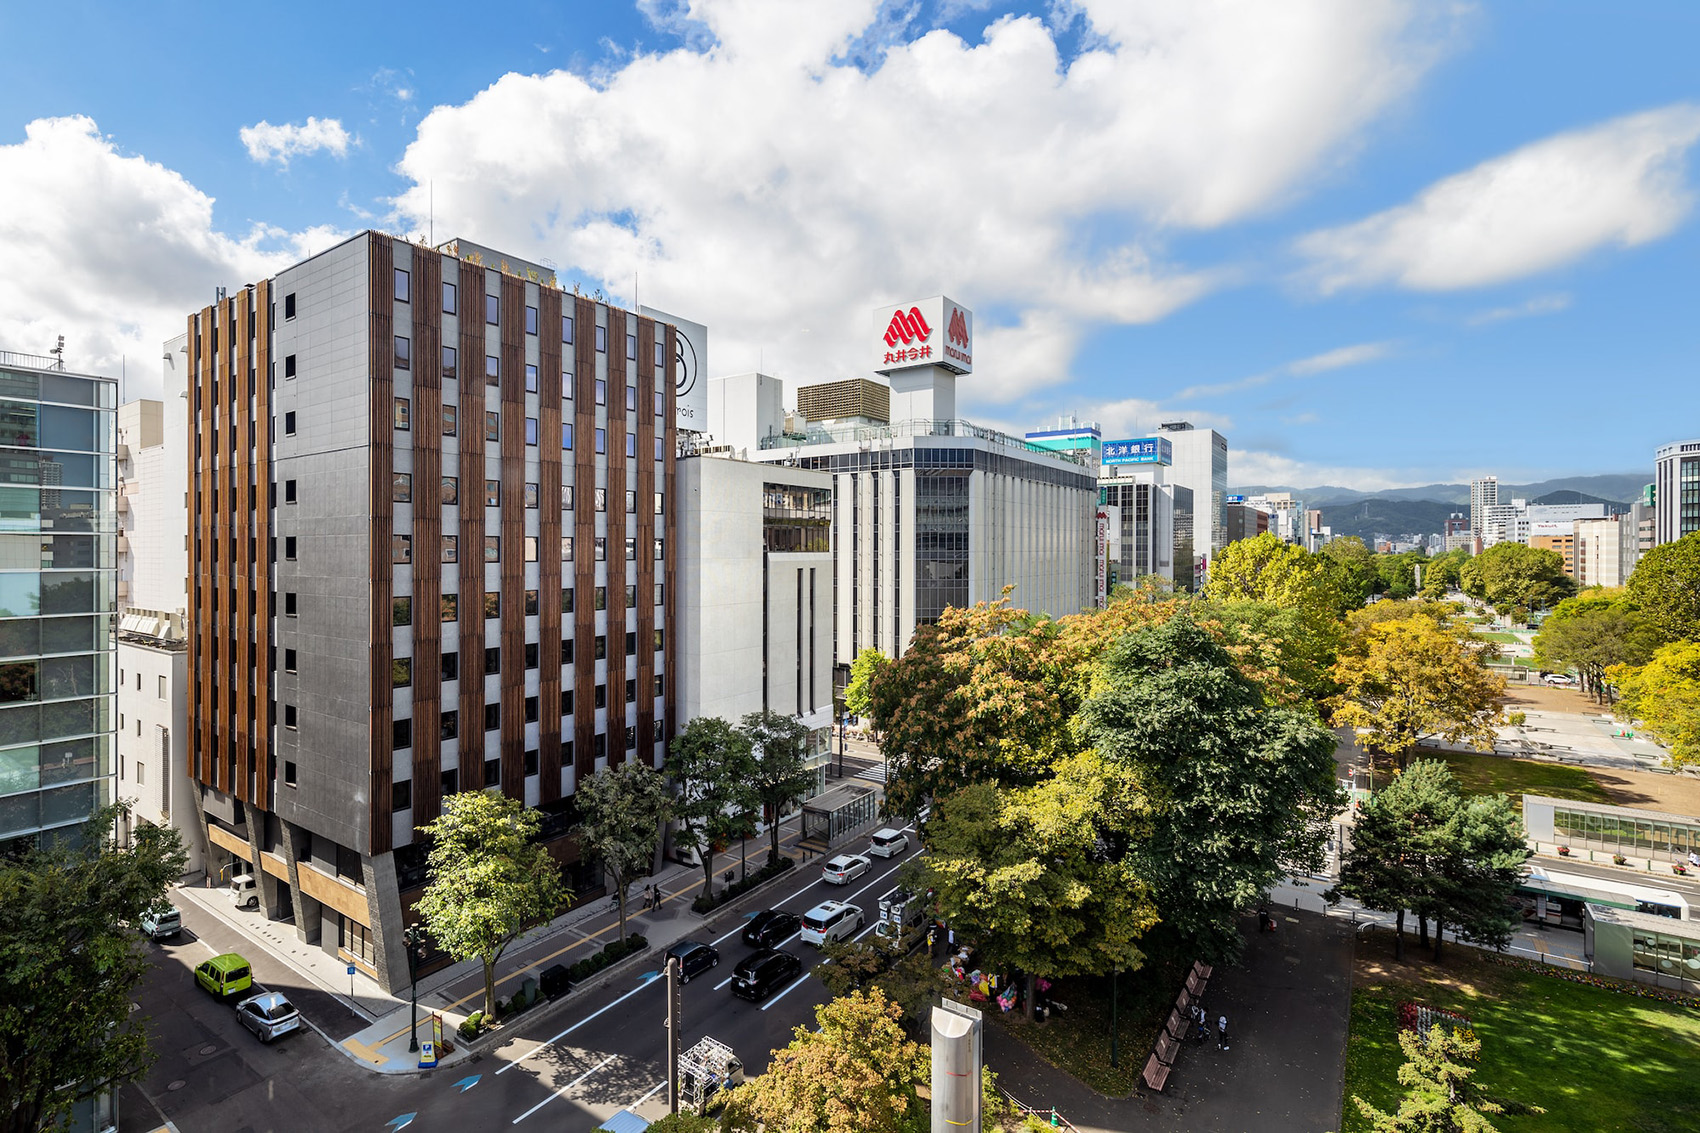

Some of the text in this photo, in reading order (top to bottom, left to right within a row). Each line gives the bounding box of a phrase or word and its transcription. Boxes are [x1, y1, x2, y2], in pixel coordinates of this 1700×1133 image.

[883, 345, 932, 364] 丸井今井
[1105, 443, 1154, 456] 北洋銀行
